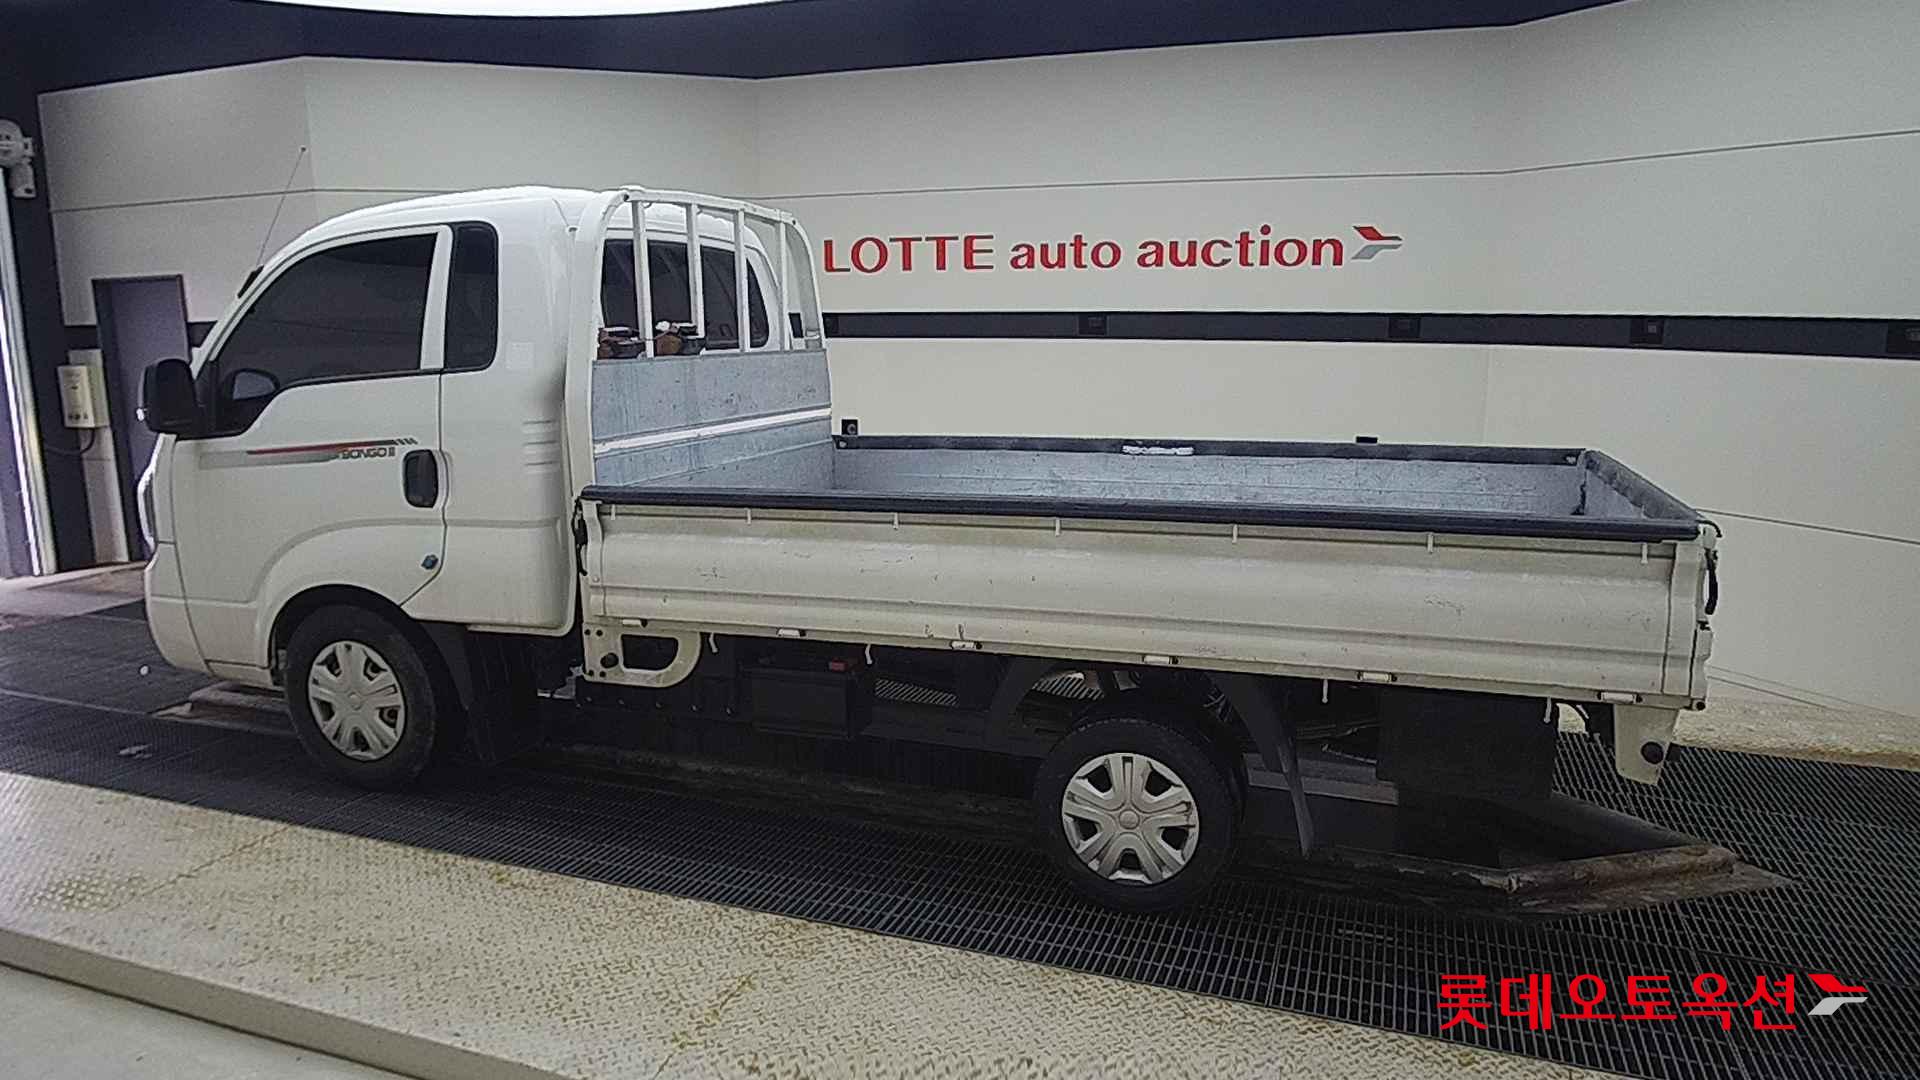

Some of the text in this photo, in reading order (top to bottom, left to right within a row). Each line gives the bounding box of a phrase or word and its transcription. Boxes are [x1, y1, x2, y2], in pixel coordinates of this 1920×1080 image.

[823, 225, 1343, 274] LOTTE auto auction
[341, 448, 387, 460] BONGO
